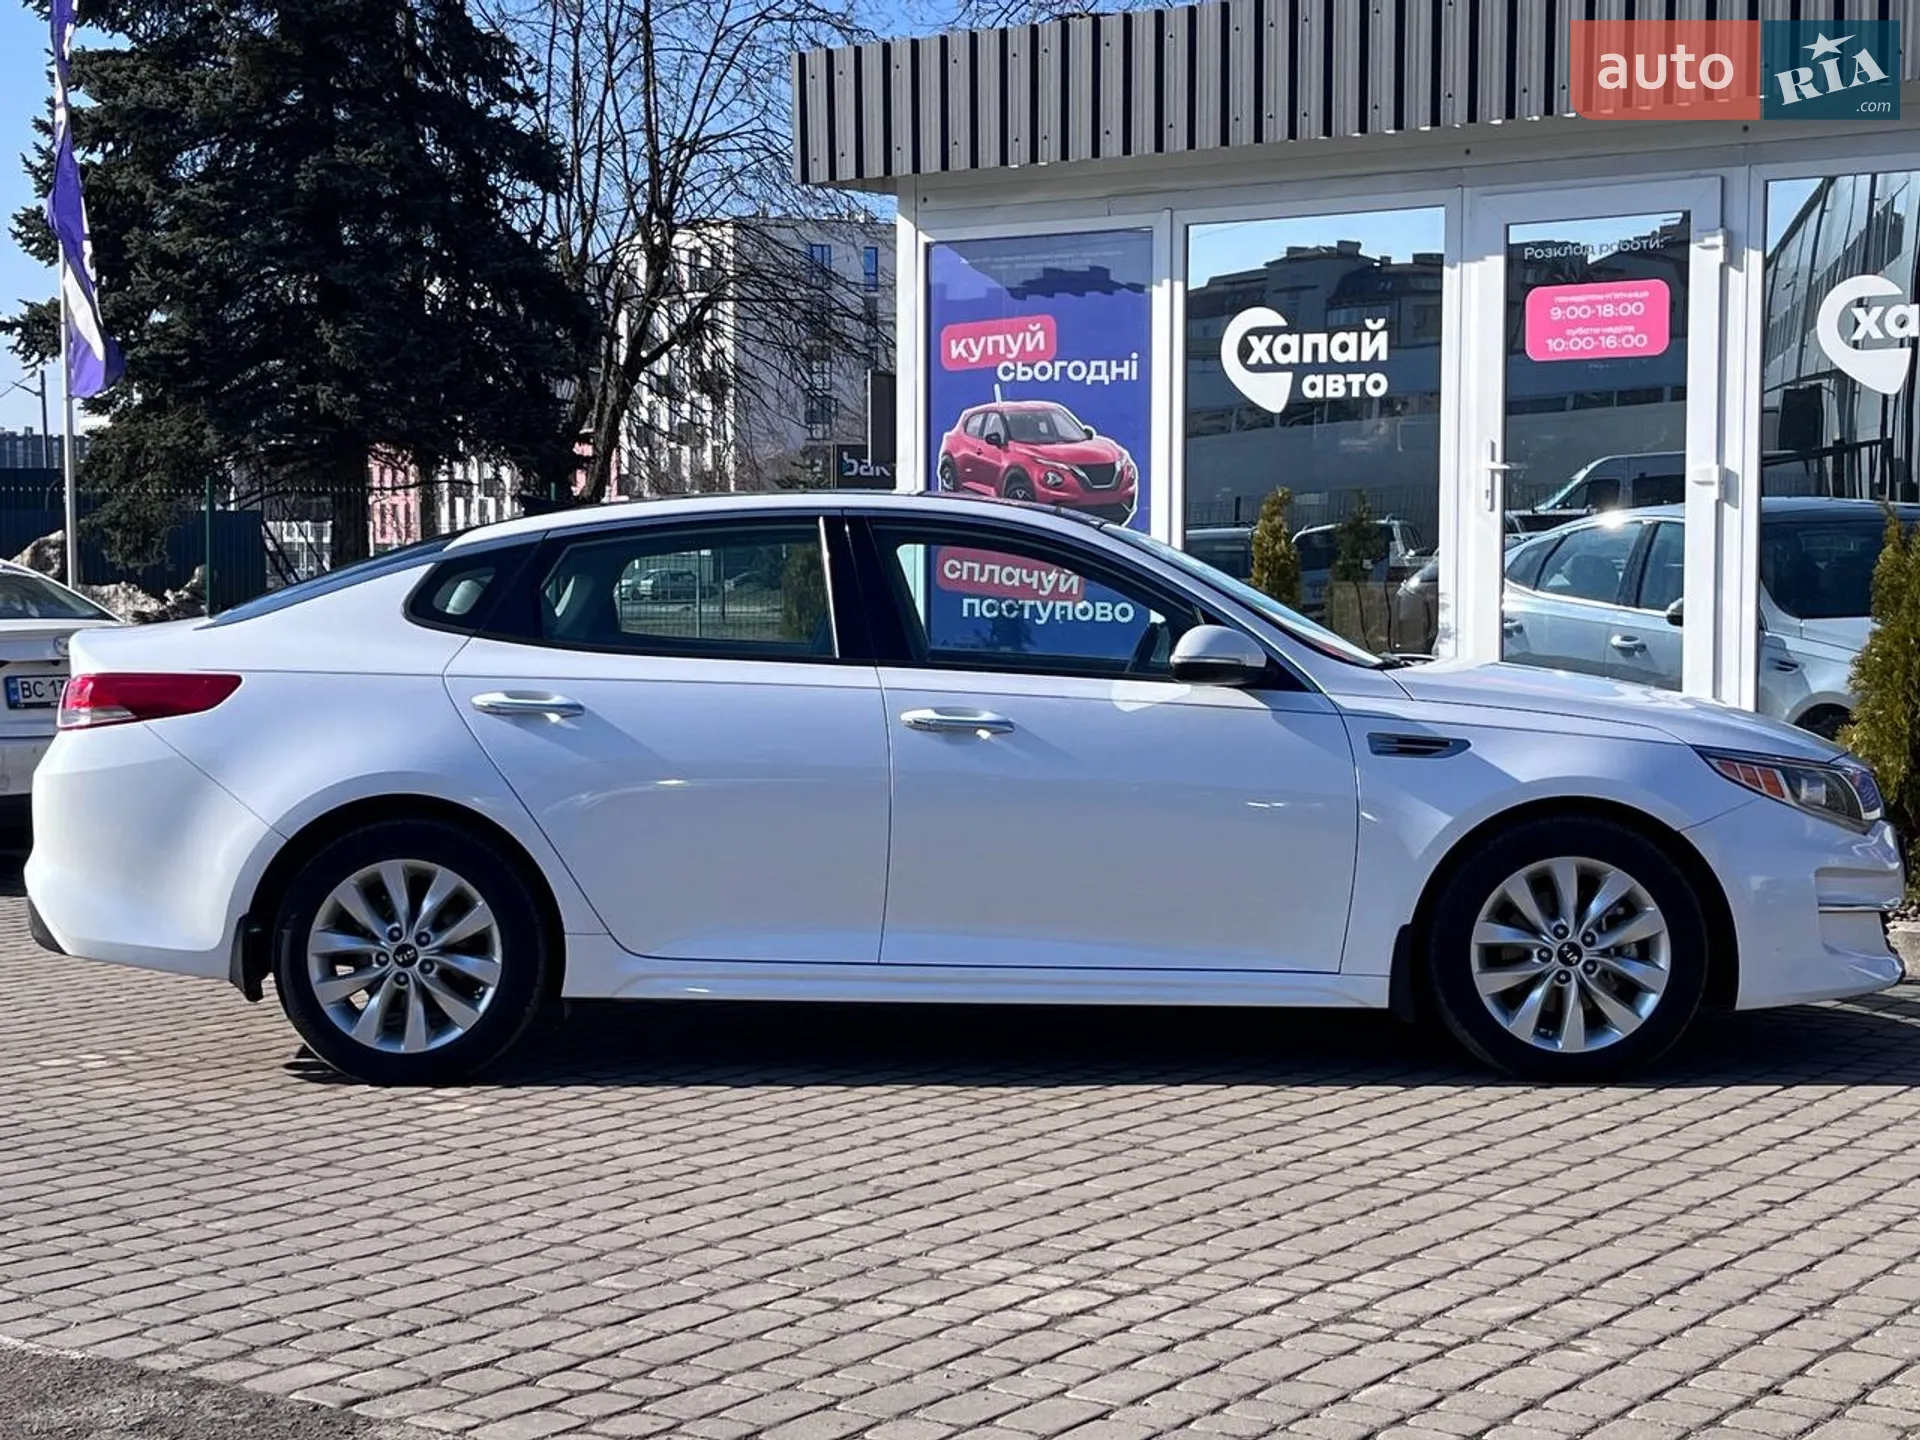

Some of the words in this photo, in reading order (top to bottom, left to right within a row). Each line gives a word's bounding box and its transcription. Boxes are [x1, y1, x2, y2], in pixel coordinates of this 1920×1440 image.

[1524, 244, 1595, 260] Розклад
[1549, 301, 1645, 320] 9:00-18:00
[950, 323, 1046, 363] купуй
[1246, 318, 1389, 365] хапай
[1546, 333, 1648, 352] 10:00-16:00
[996, 352, 1139, 385] сьогодні
[1301, 372, 1389, 399] авто
[943, 558, 1081, 595] сплачуй
[962, 598, 1135, 625] поступово
[20, 680, 45, 699] BC
